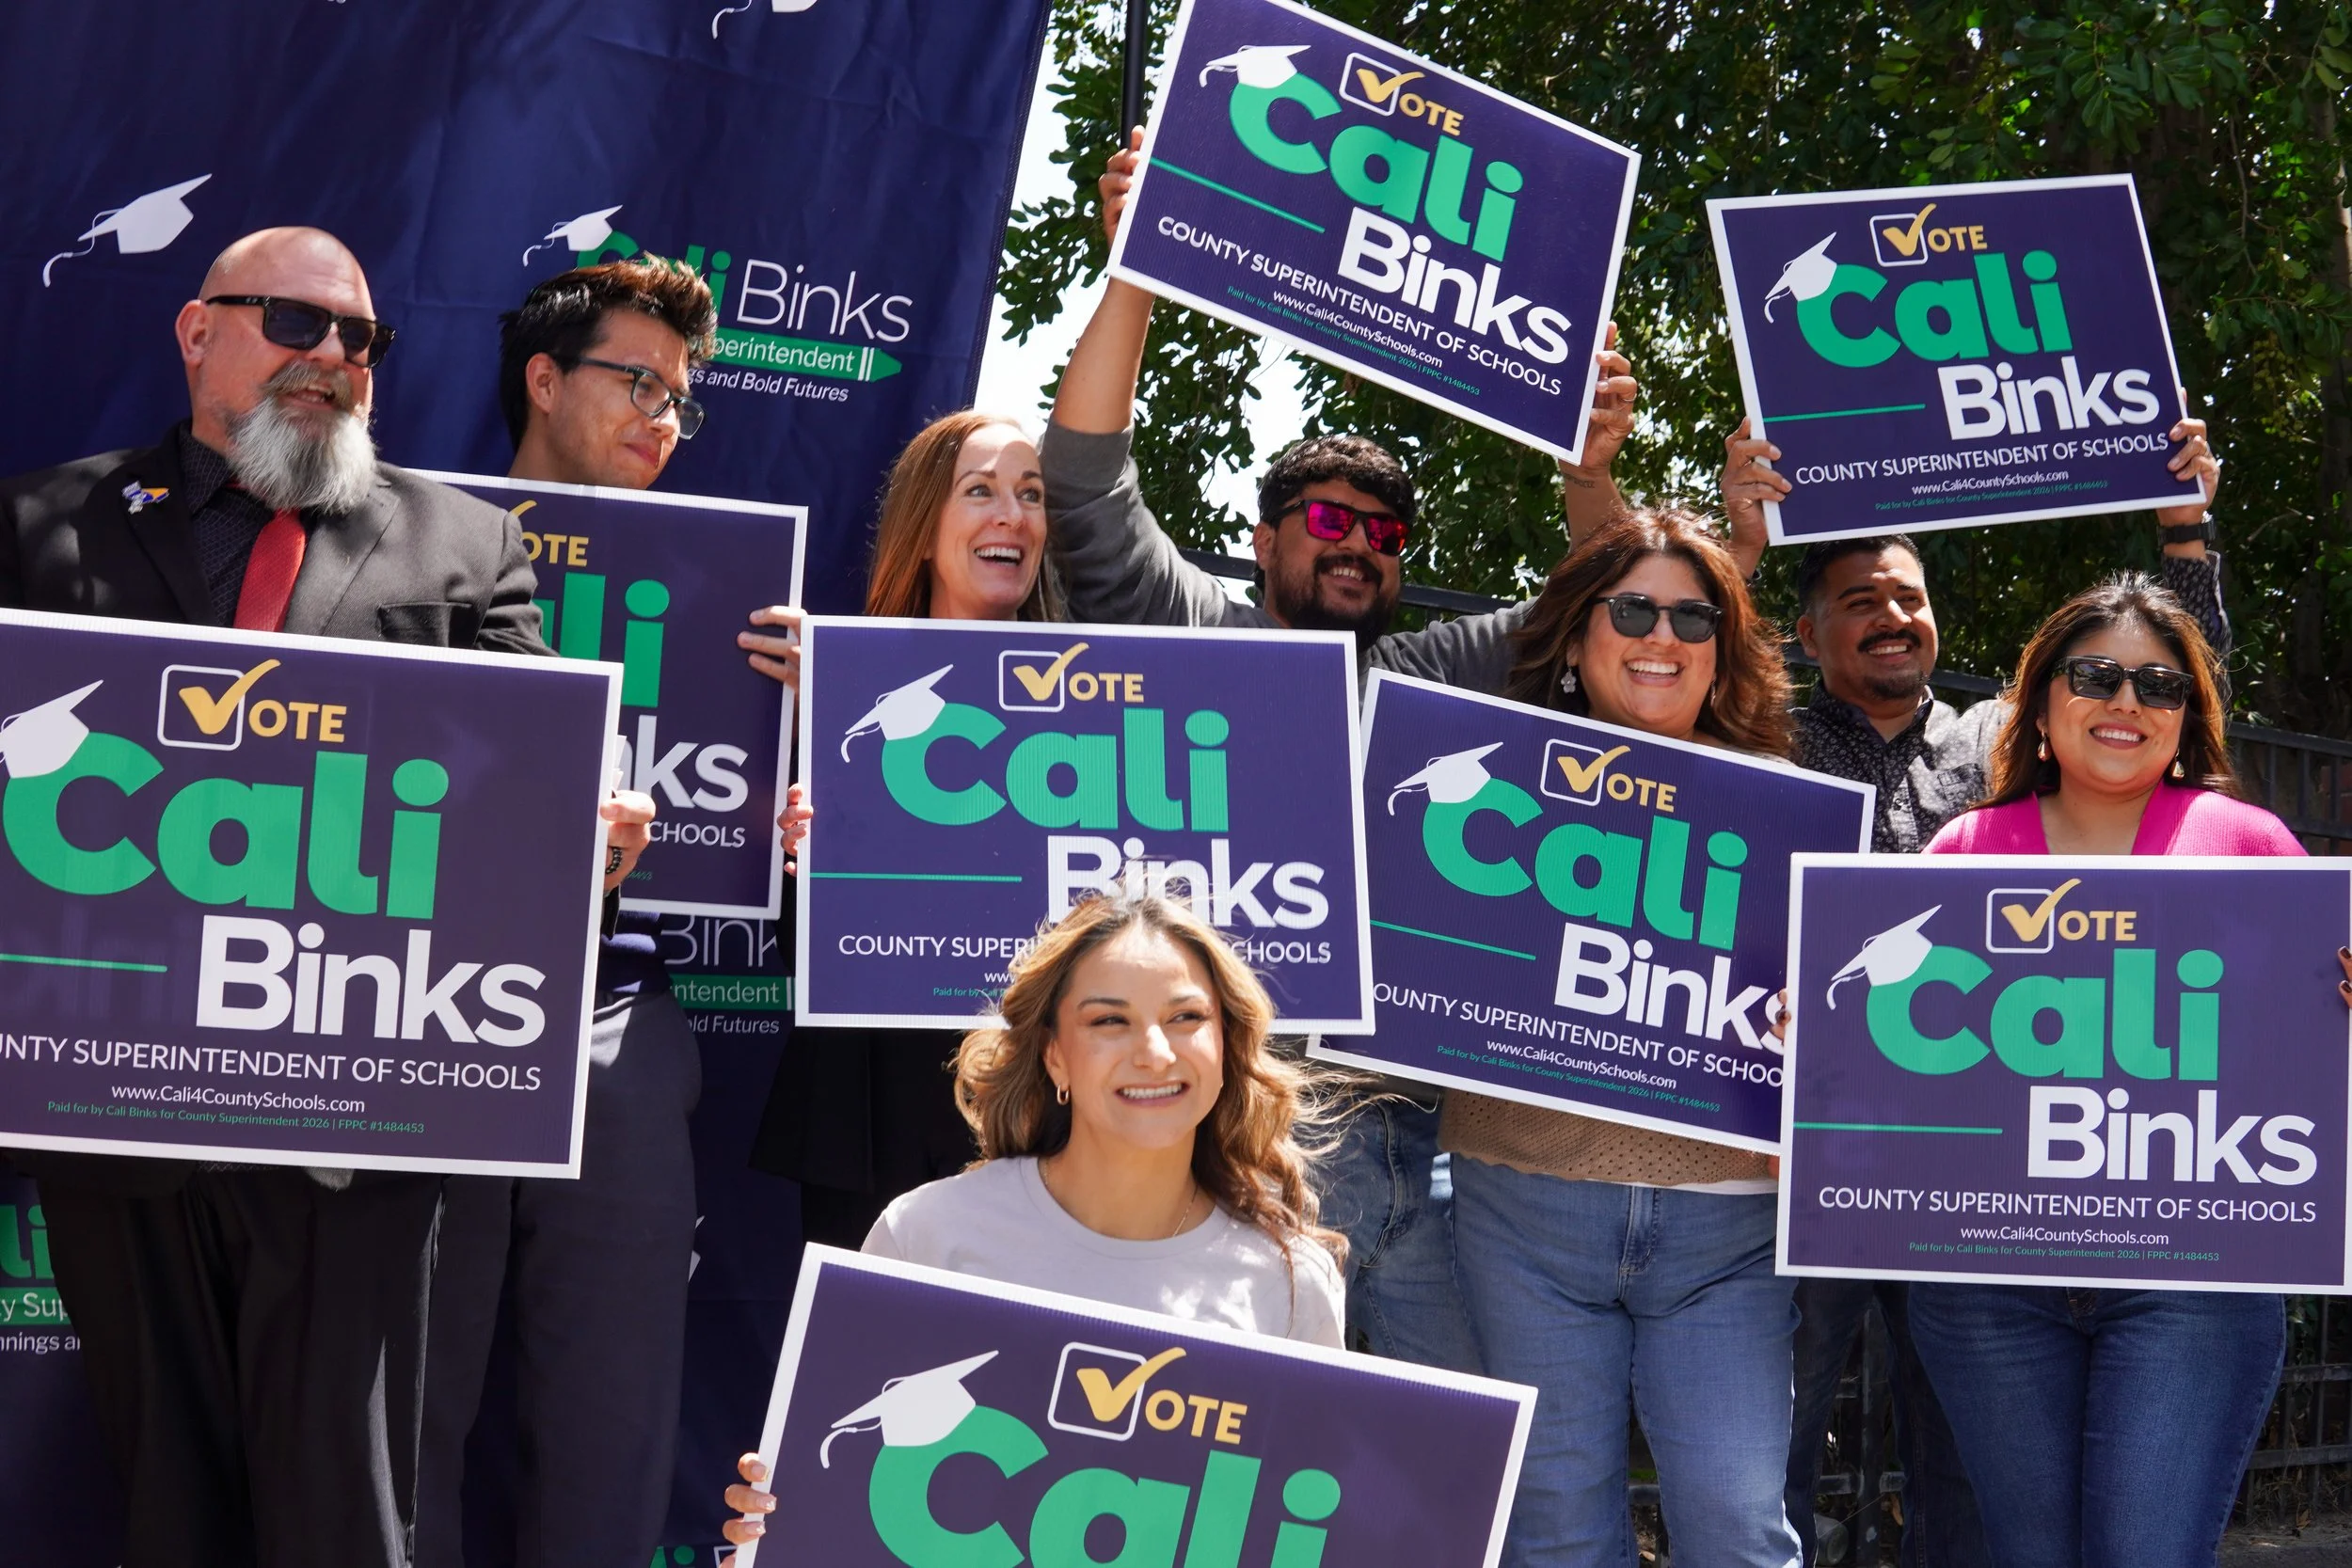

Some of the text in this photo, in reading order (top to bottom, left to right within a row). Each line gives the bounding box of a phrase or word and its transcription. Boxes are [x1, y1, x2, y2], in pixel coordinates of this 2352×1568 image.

[1229, 72, 1524, 262] Cali
[737, 259, 914, 342] Binks
[1158, 215, 1562, 395] COUNTY SUPERINTENDENT OF SCHOOLS
[1337, 207, 1572, 364] Binks
[1796, 249, 2073, 368] Cali
[711, 337, 855, 372] perintendent
[1227, 285, 1244, 299] Paid
[1245, 292, 1256, 304] for
[1257, 296, 1268, 309] by
[1303, 314, 1314, 326] for
[1315, 323, 1342, 340] County
[1343, 333, 1398, 361] Superintendent
[1398, 356, 1417, 370] 2026
[1422, 365, 1442, 380] FPPC
[1273, 291, 1443, 368] www.Cali4CountySchools.com
[707, 372, 740, 388] and
[741, 372, 779, 394] Bold
[784, 378, 850, 402] Futures
[1937, 356, 2160, 441] Binks
[1795, 432, 2169, 484] COUNTY SUPERINTENDENT OF SCHOOLS
[1911, 470, 2070, 495] www.Cali4CountySchools.com
[881, 703, 1230, 832] Cali
[2, 732, 450, 920] Cali
[649, 821, 746, 848] CHOOLS
[1422, 777, 1748, 951] Cali
[838, 935, 946, 957] COUNTY
[1231, 941, 1331, 964] CHOOLS
[196, 914, 547, 1048] Binks
[672, 980, 780, 1004] ntendent
[932, 988, 952, 996] Paid
[954, 988, 967, 996] for
[968, 988, 979, 999] by
[689, 1015, 780, 1034] ld Futures
[1374, 983, 1784, 1087] OUNTY SUPERINTENDENT OF SCHOO
[1866, 945, 2224, 1081] Cali
[0, 1033, 542, 1091] NTY SUPERINTENDENT OF SCHOOLS
[1437, 1045, 1455, 1055] Paid
[1456, 1048, 1469, 1059] for
[1470, 1051, 1481, 1063] by
[1481, 1054, 1498, 1066] Cali
[1499, 1058, 1520, 1070] Binks
[1521, 1061, 1534, 1073] for
[1534, 1066, 1564, 1080] County
[1565, 1071, 1627, 1092] Superintendent
[1628, 1085, 1649, 1098] 2026
[1655, 1091, 1677, 1103] FPPC
[1486, 1040, 1677, 1089] www.Cali4CountySchools.com
[47, 1101, 71, 1113] Paid
[73, 1102, 88, 1114] for
[90, 1103, 104, 1117] by
[106, 1105, 126, 1117] Cali
[129, 1106, 158, 1118] Binks
[160, 1108, 176, 1120] for
[178, 1110, 216, 1123] County
[218, 1113, 300, 1127] Superintendent
[301, 1117, 330, 1128] 2026
[338, 1118, 367, 1131] FPPC
[370, 1120, 424, 1133] #1484453
[111, 1085, 365, 1113] www.Cali4CountySchools.com
[2026, 1085, 2318, 1185] Binks
[1819, 1186, 2316, 1222] COUNTY SUPERINTENDENT OF SCHOOLS
[1909, 1242, 1928, 1251] Paid
[1930, 1242, 1943, 1252] for
[1944, 1243, 1955, 1254] by
[1957, 1243, 1973, 1254] Cali
[1975, 1244, 1999, 1254] Binks
[2000, 1244, 2013, 1255] for
[2014, 1245, 2047, 1257] County
[2048, 1247, 2115, 1259] Superintendent
[2116, 1248, 2140, 1259] 2026
[2147, 1250, 2171, 1260] FPPC
[2173, 1250, 2220, 1261] #1484453
[1961, 1226, 2169, 1245] www.Cali4CountySchools.com
[867, 1404, 1342, 1568] Cali
